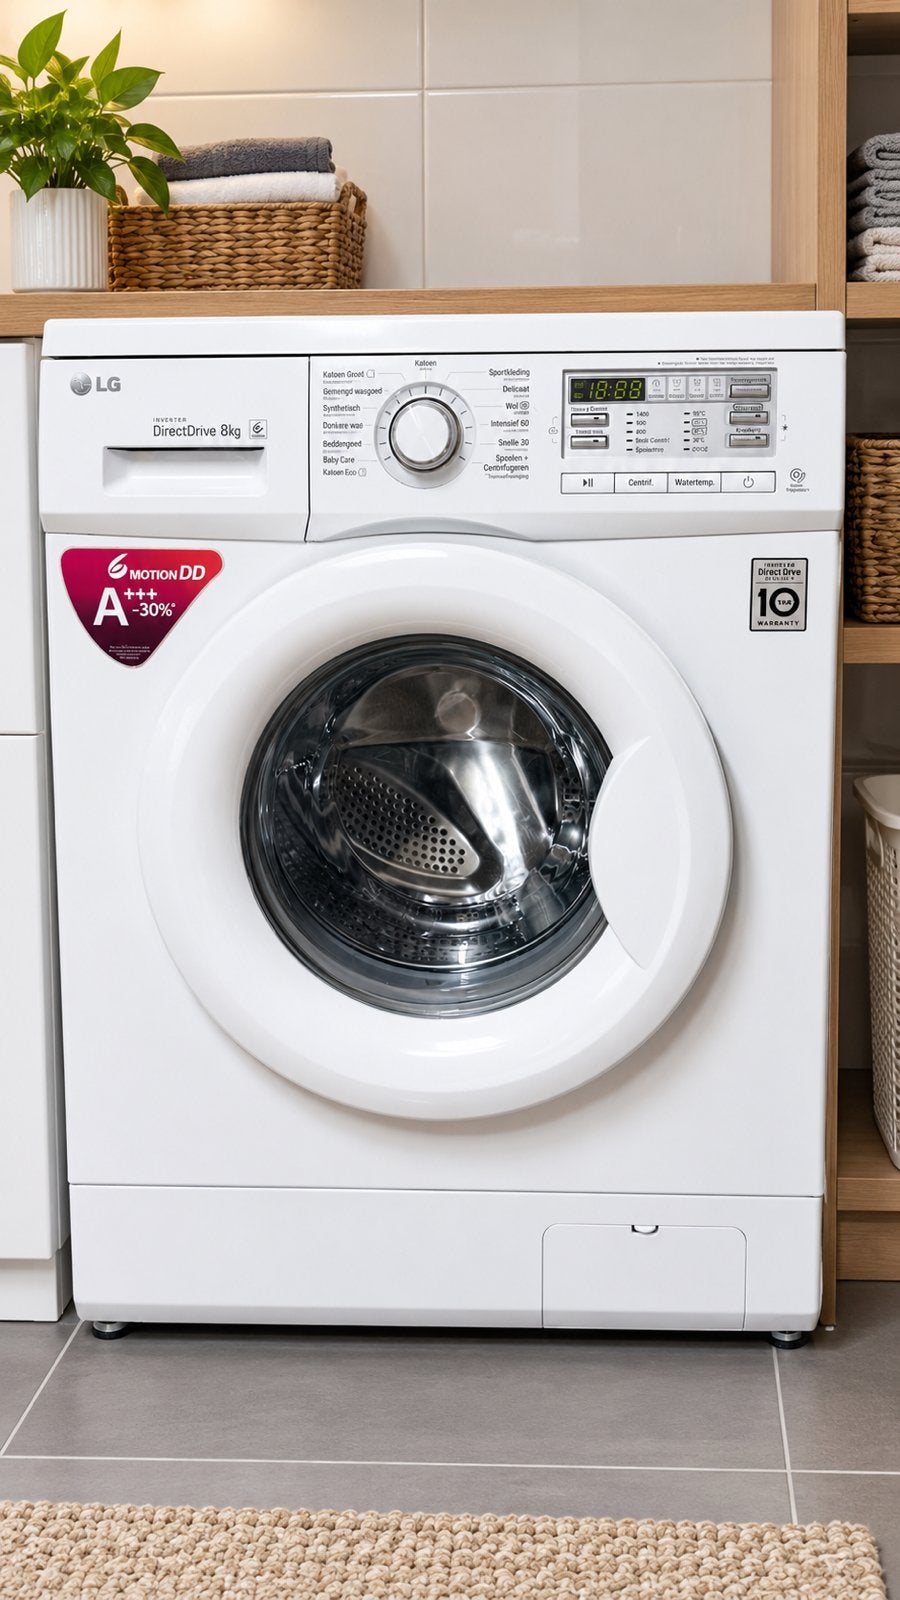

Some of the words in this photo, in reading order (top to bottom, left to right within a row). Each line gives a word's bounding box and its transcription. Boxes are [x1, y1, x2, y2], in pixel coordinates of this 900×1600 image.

[489, 368, 530, 377] Sportkleding
[96, 376, 121, 392] LG
[322, 388, 353, 396] Gemengd
[354, 388, 382, 396] wasgoed
[153, 425, 216, 437] DirectDrive
[220, 424, 240, 439] 8kg
[322, 456, 339, 465] Baby
[675, 478, 715, 487] Watertemp.
[130, 570, 178, 580] MOTION
[179, 565, 206, 580] DD
[758, 588, 800, 617] 10
